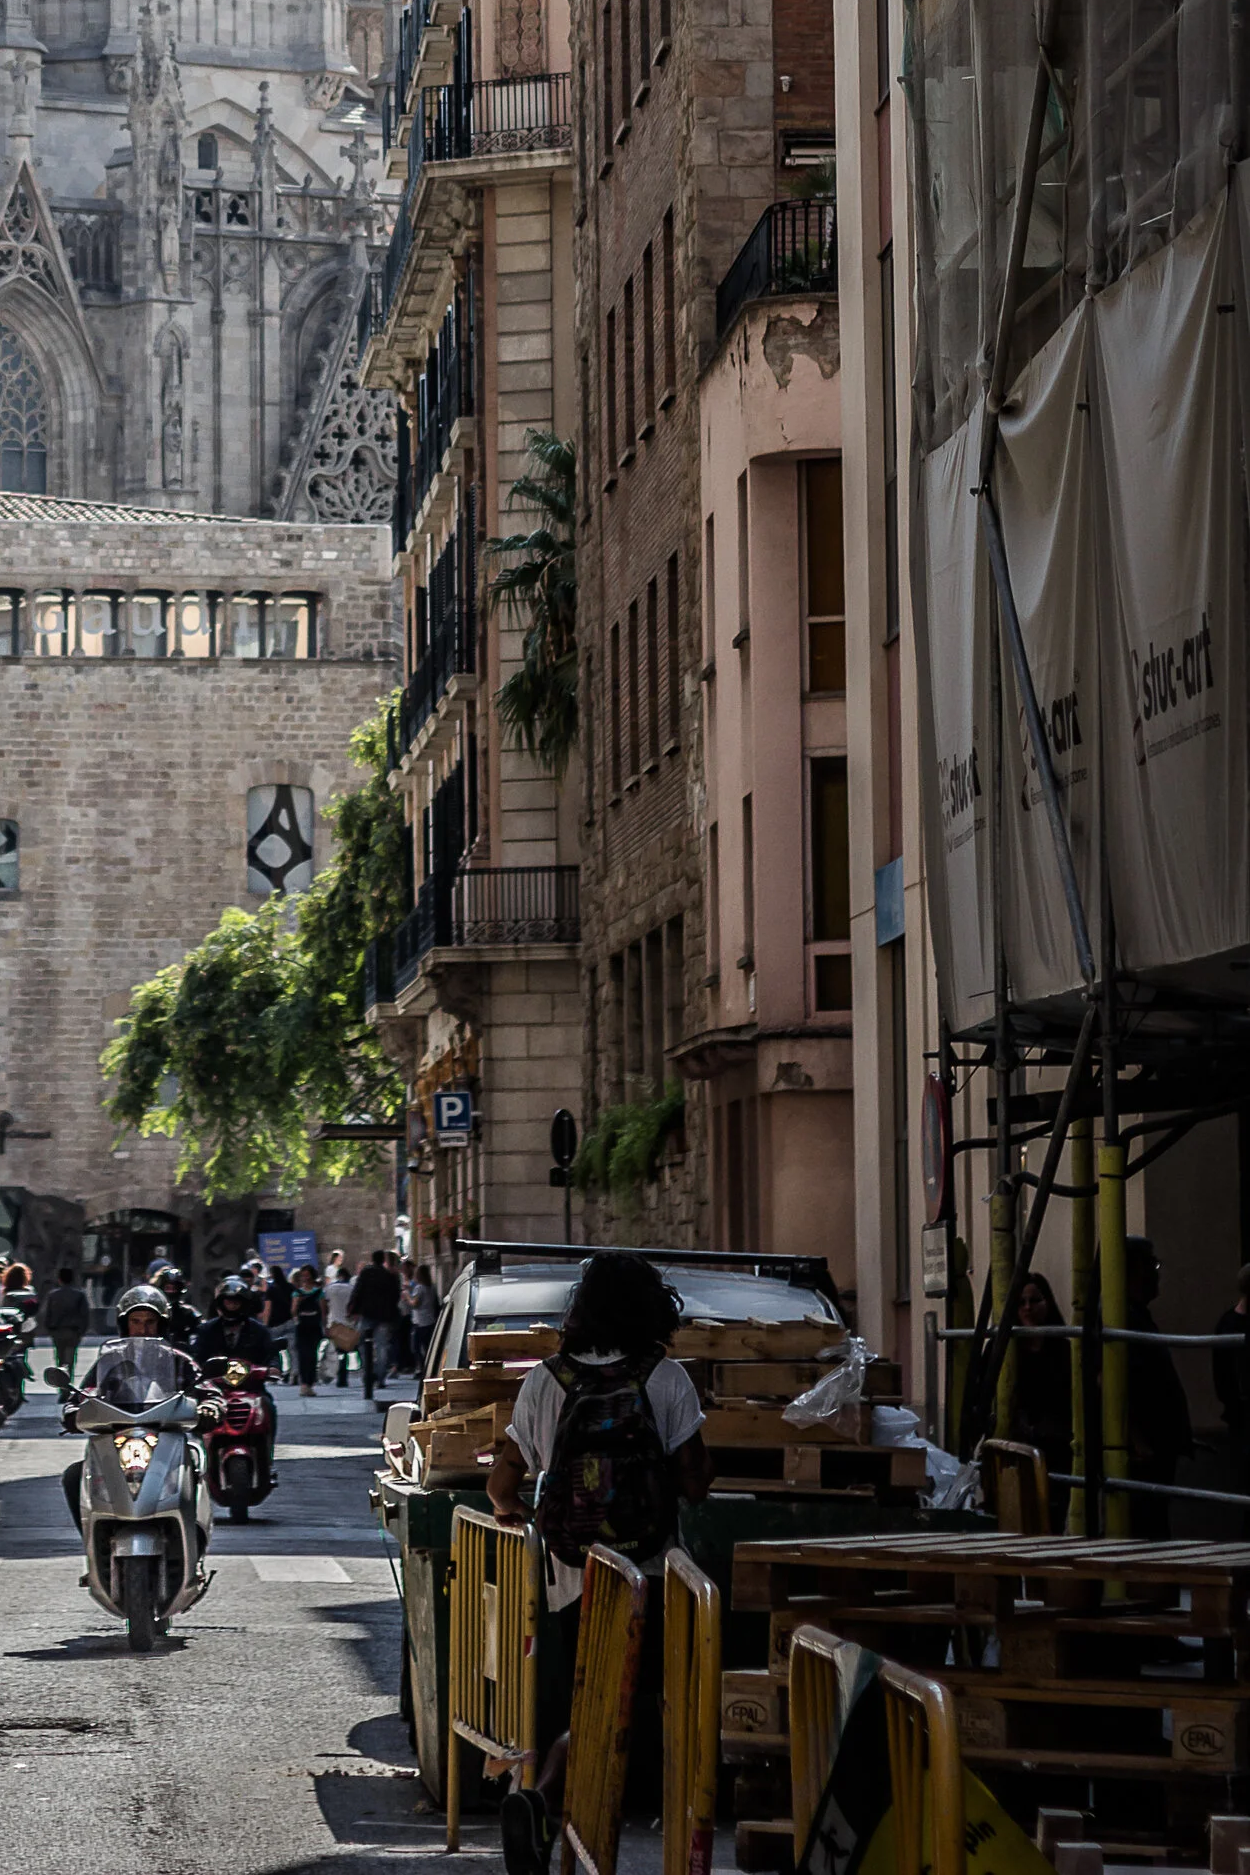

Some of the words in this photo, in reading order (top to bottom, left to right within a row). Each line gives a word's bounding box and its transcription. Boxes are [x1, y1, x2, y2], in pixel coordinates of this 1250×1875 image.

[1143, 612, 1214, 721] stuc-art
[441, 1097, 463, 1128] P
[1188, 1731, 1219, 1750] EPAL
